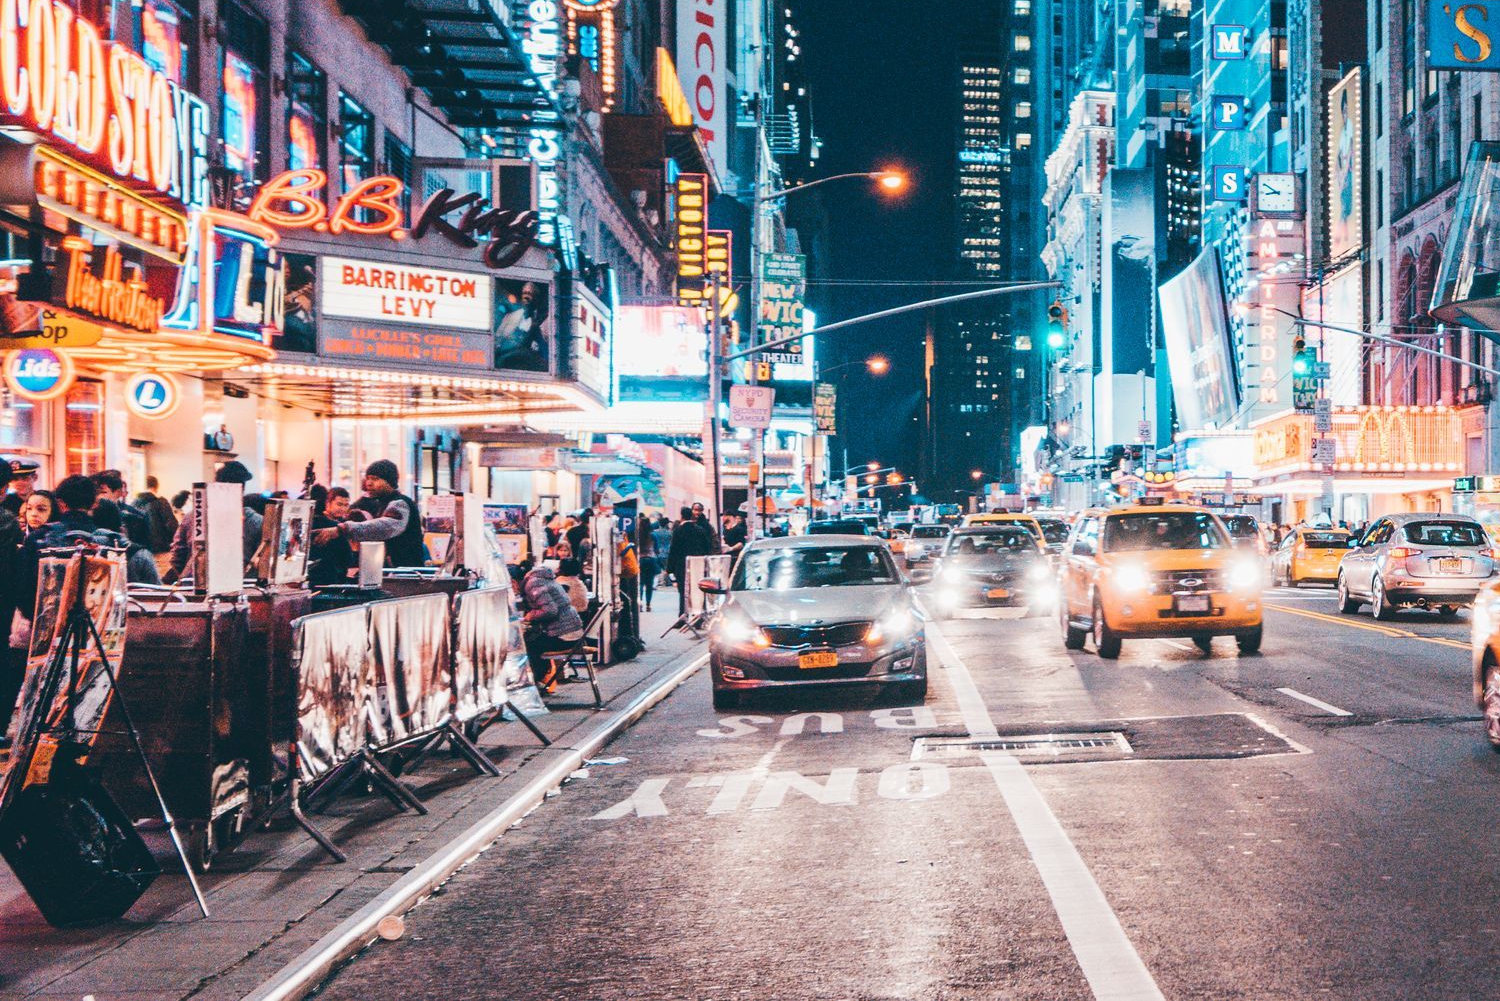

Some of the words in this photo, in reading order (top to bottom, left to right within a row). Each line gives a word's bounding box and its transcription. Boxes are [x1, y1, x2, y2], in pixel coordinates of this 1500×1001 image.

[108, 43, 210, 211] STONE
[411, 187, 538, 270] King
[678, 178, 703, 277] VICTORY
[342, 264, 476, 298] BARRINGTON
[763, 283, 796, 299] NEW
[381, 294, 436, 319] LEVY
[1259, 220, 1279, 404] AMSTERDAM
[11, 358, 62, 378] Lids
[762, 351, 804, 365] THEATER
[696, 705, 938, 739] BUS
[587, 761, 952, 820] ONLY
